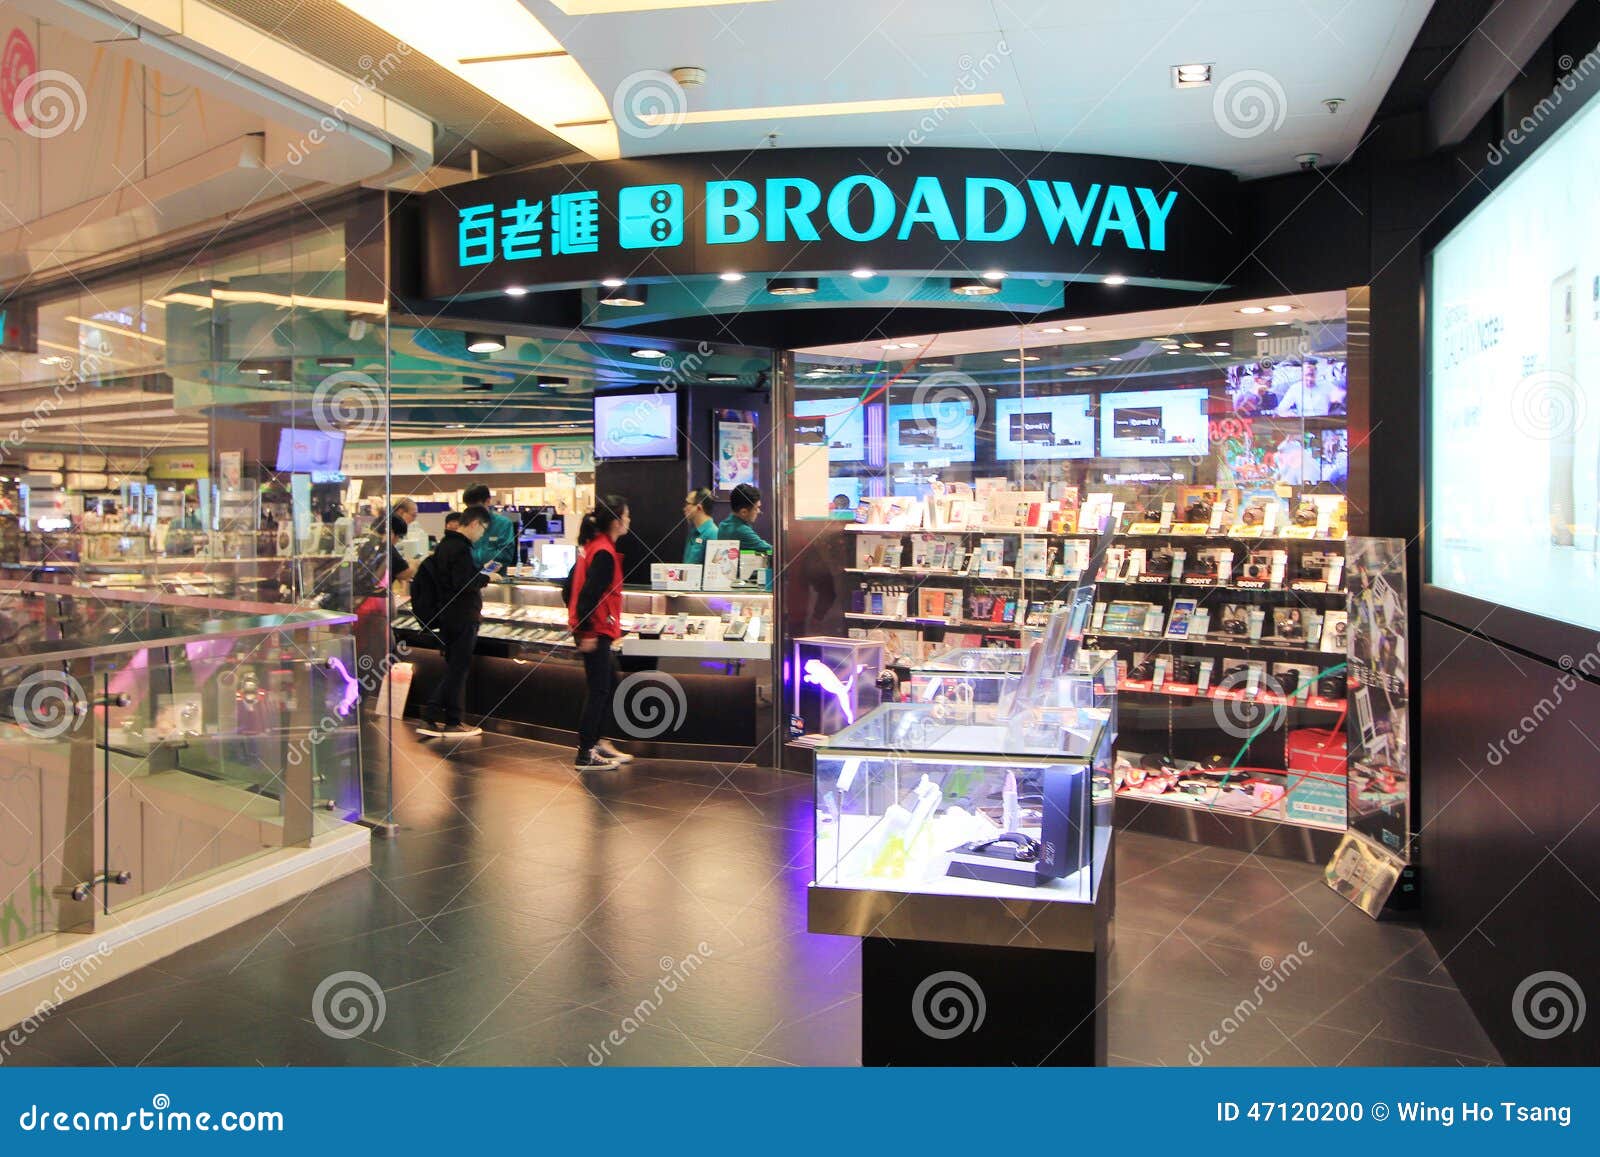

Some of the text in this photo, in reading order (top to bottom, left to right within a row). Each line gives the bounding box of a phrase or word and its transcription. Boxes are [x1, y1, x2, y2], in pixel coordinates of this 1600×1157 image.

[706, 174, 1178, 251] BROADWAY
[1185, 577, 1212, 585] SONY
[1237, 580, 1265, 589] SONY
